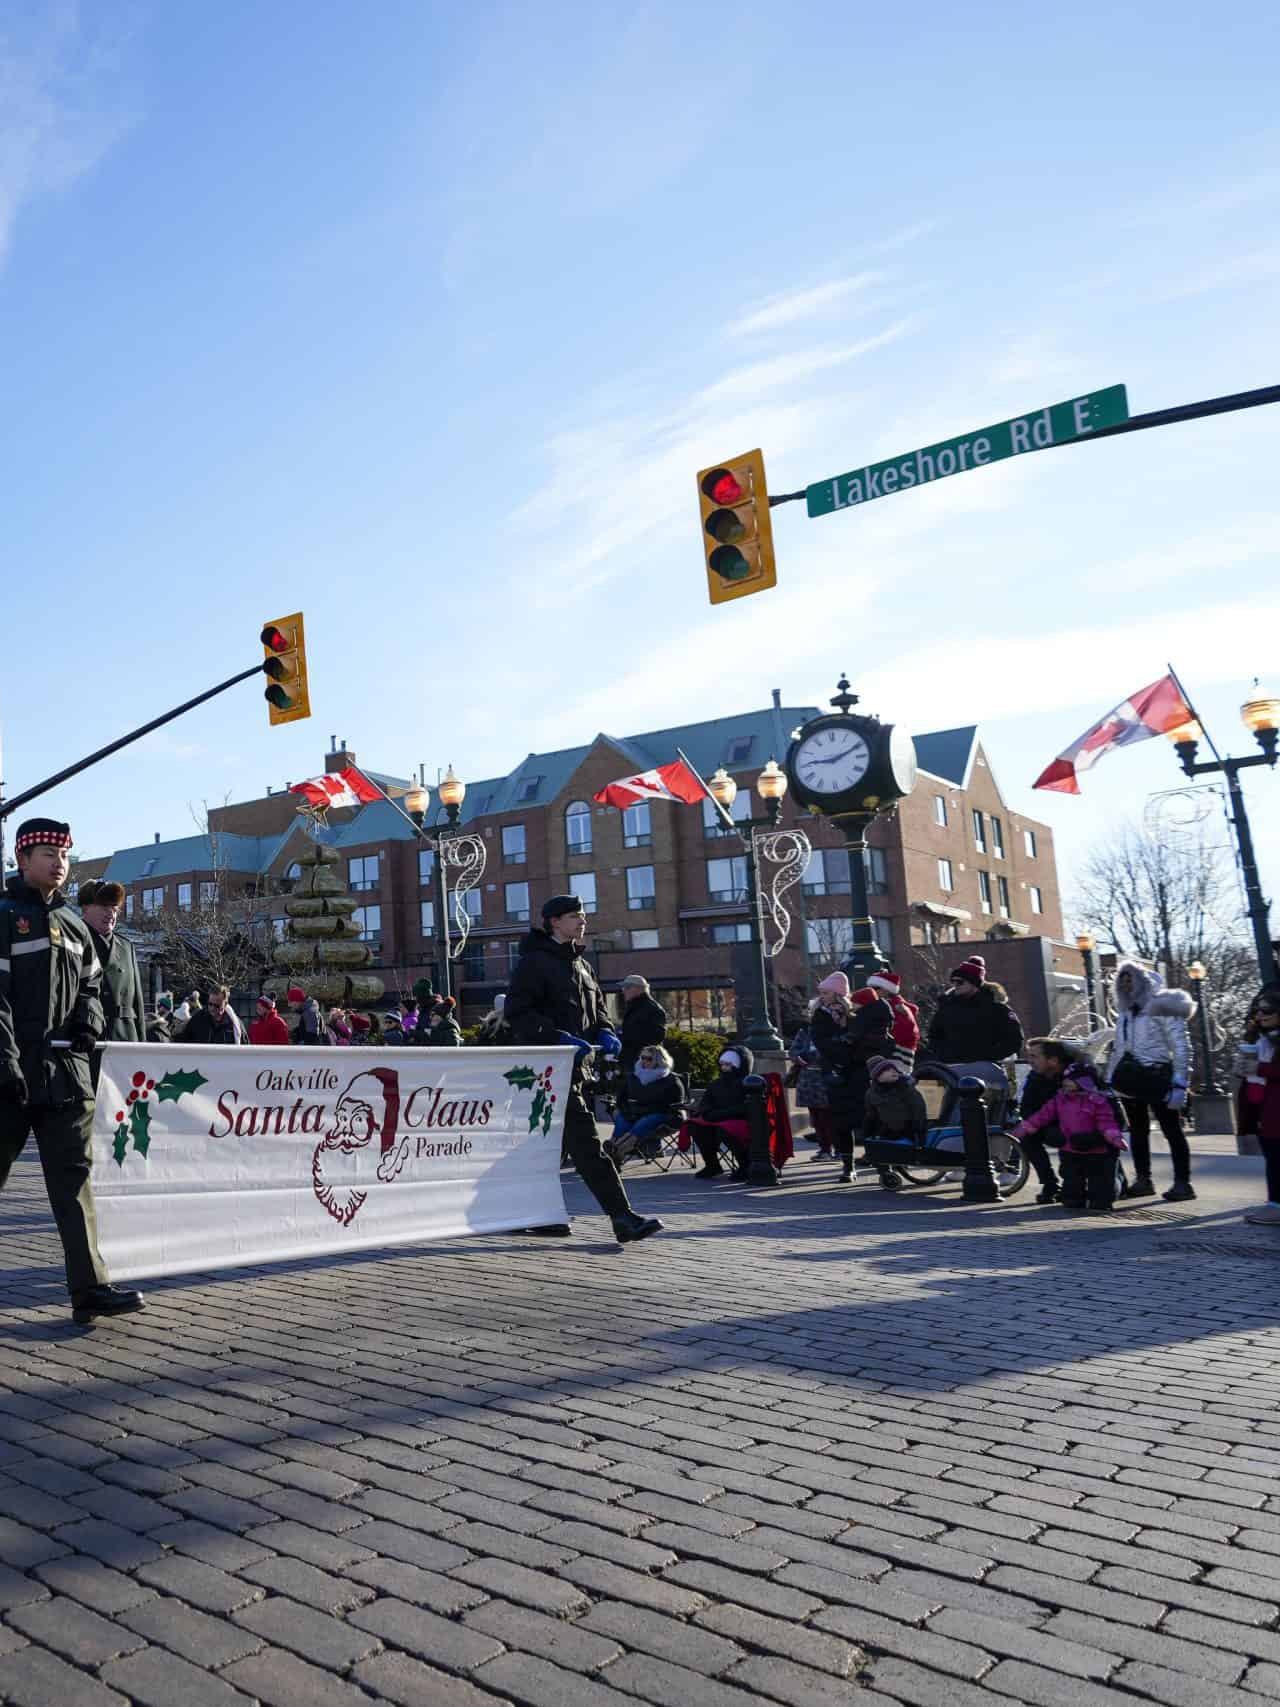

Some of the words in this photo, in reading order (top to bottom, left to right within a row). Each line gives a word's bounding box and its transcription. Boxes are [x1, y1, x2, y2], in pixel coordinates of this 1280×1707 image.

[831, 436, 992, 510] Lakeshore
[1009, 407, 1055, 454] Rd
[1073, 398, 1093, 435] E
[255, 1068, 339, 1091] Oakville
[208, 1089, 326, 1139] Santa
[403, 1086, 494, 1128] Claus
[415, 1135, 473, 1158] Parade
